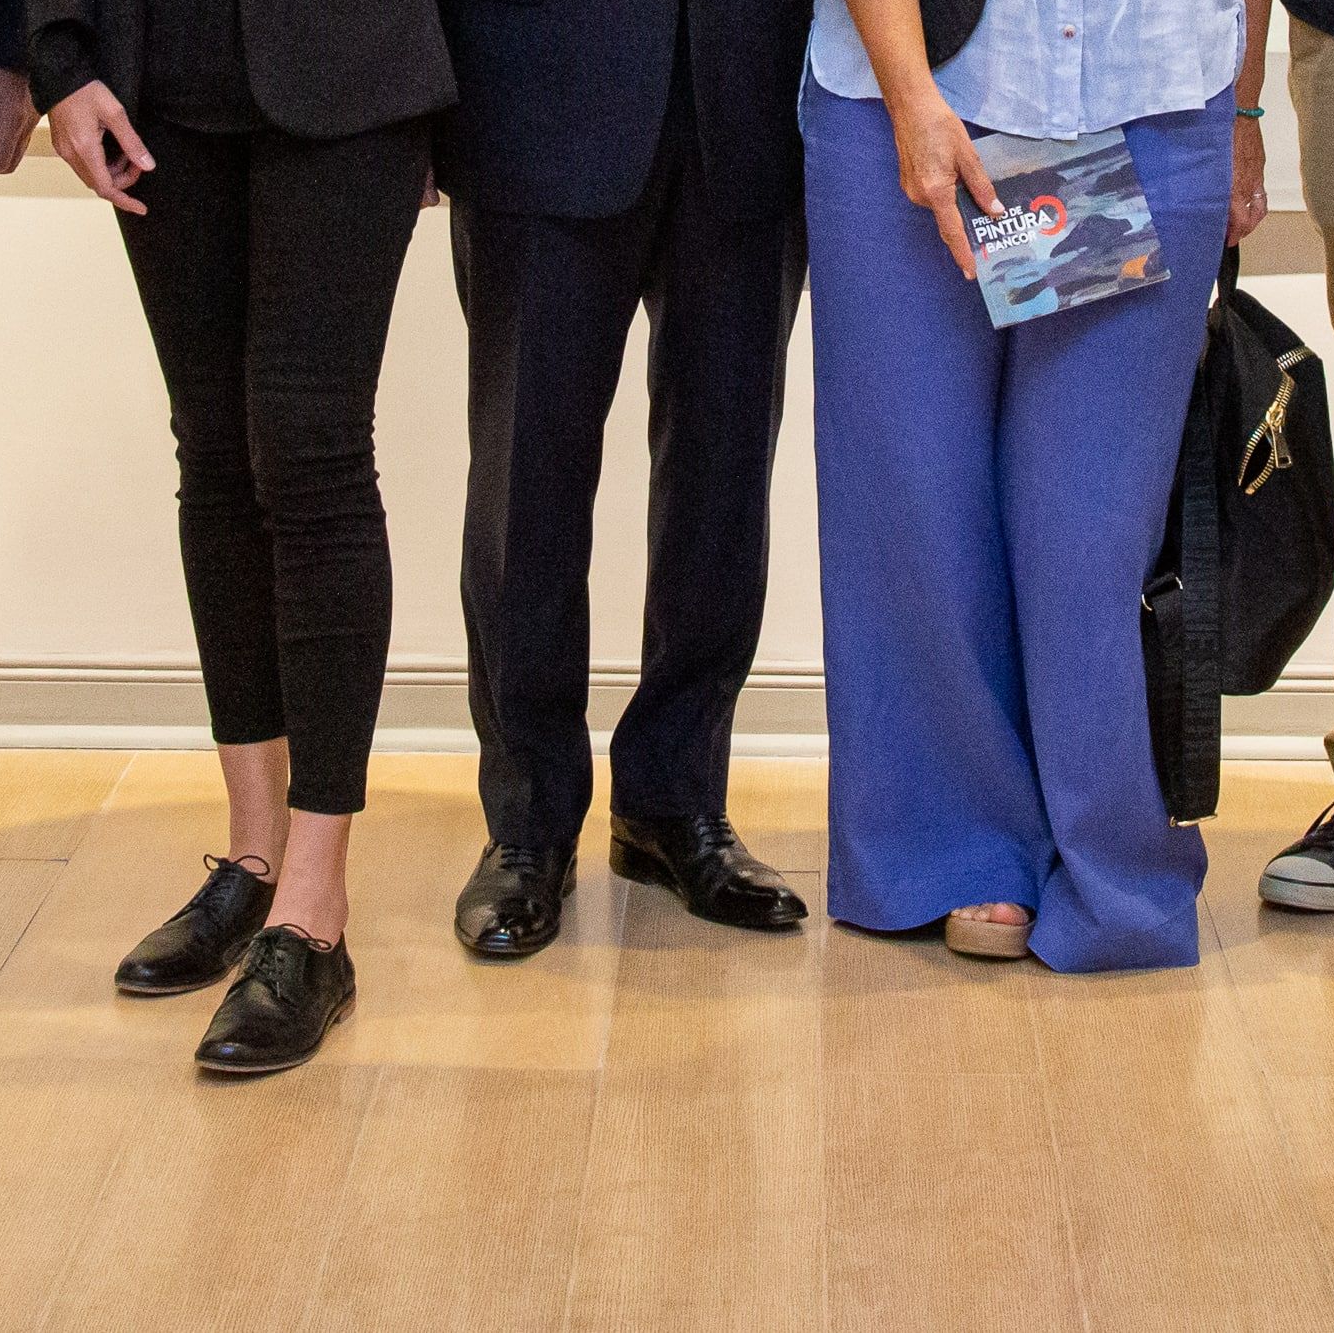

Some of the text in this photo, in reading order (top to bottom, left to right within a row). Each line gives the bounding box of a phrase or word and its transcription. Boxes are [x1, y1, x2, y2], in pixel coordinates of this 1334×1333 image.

[971, 205, 1023, 228] PREO DE
[974, 209, 1052, 243] PINTURA
[985, 230, 1037, 253] BANCOR
